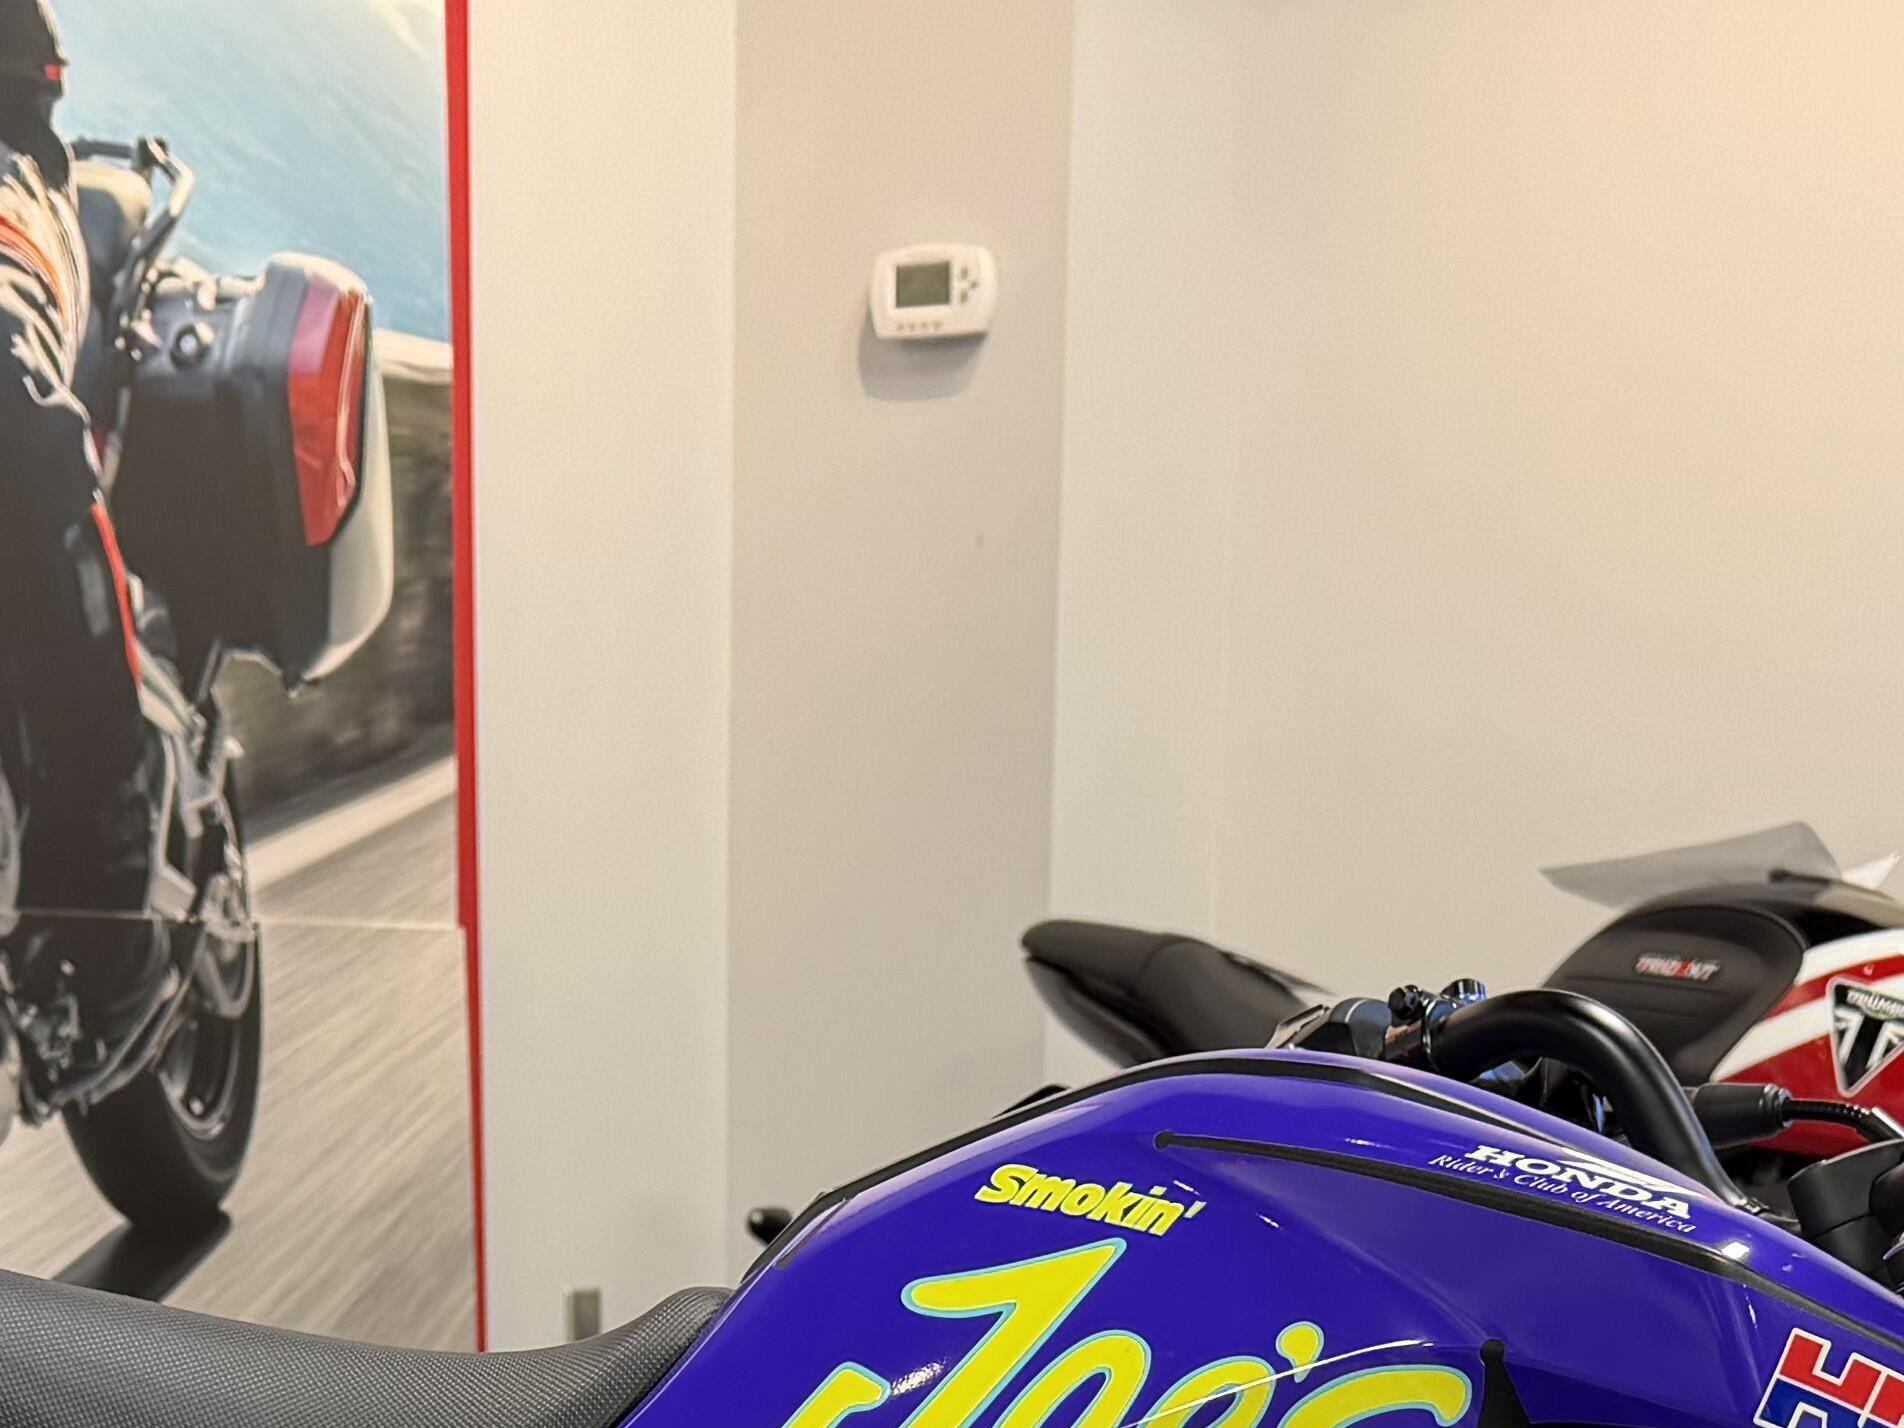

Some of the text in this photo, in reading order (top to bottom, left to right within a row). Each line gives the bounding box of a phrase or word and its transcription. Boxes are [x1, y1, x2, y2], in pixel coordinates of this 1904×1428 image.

[1463, 1143, 1692, 1220] HONDA
[1513, 1173, 1569, 1195] Club
[1571, 1186, 1602, 1203] of
[1597, 1196, 1697, 1234] America
